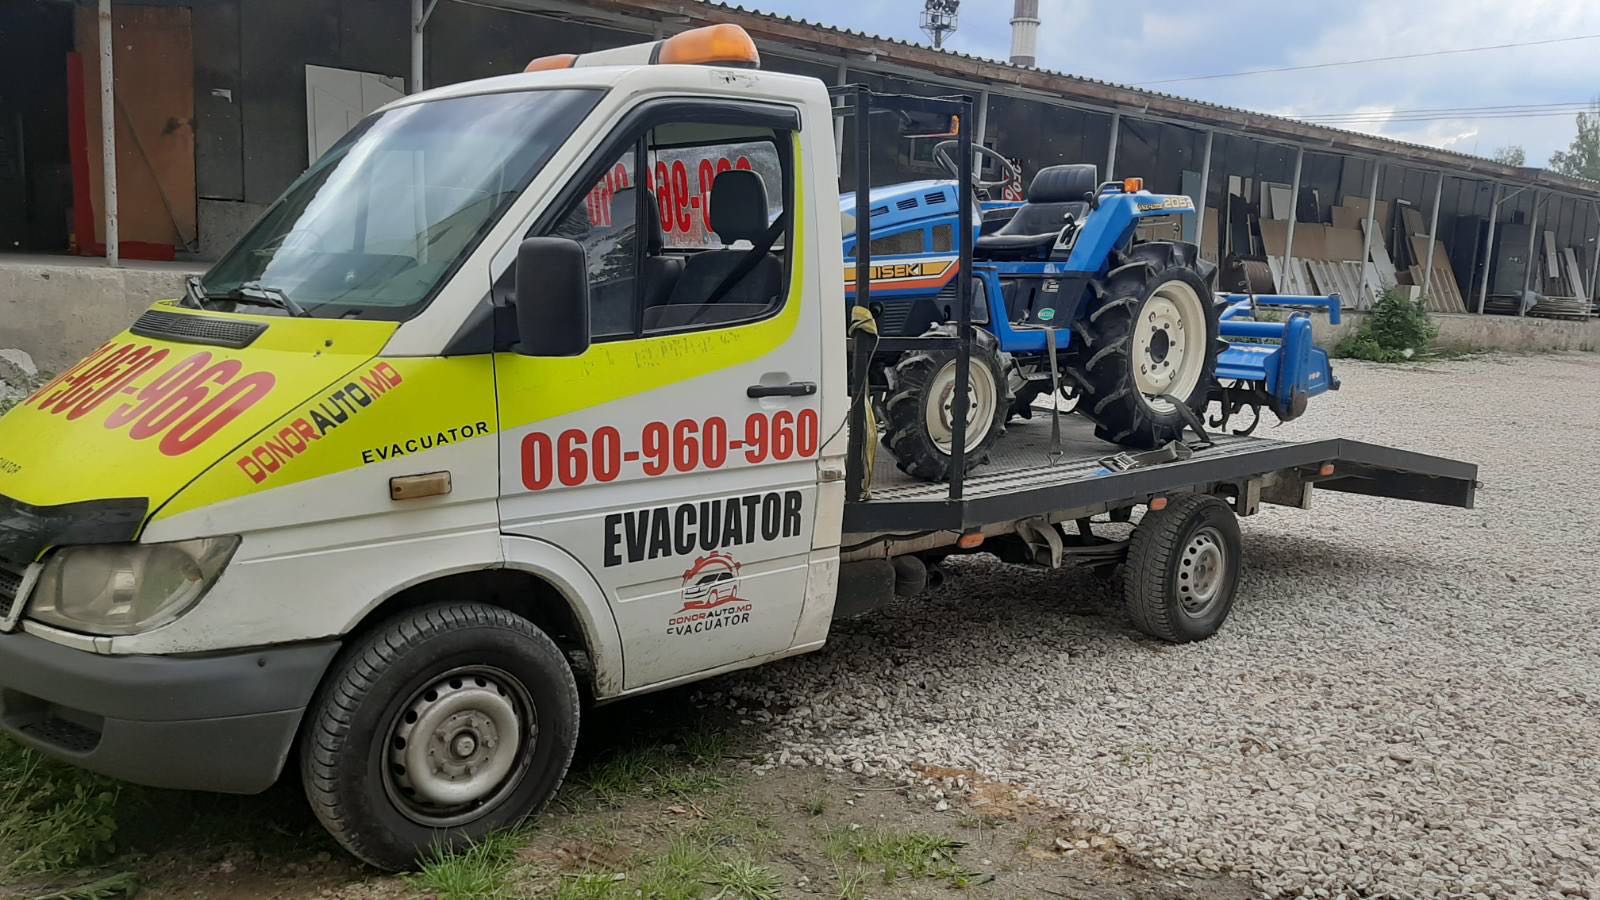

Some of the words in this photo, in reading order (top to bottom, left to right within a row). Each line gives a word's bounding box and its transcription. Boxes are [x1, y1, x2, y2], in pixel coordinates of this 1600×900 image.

[236, 361, 404, 485] DONORAUTO.MD
[361, 420, 489, 465] EVACUATOR
[520, 408, 819, 491] 060-960-960
[603, 490, 803, 568] EVACUATOR
[668, 603, 753, 626] DONORAUTO.MD
